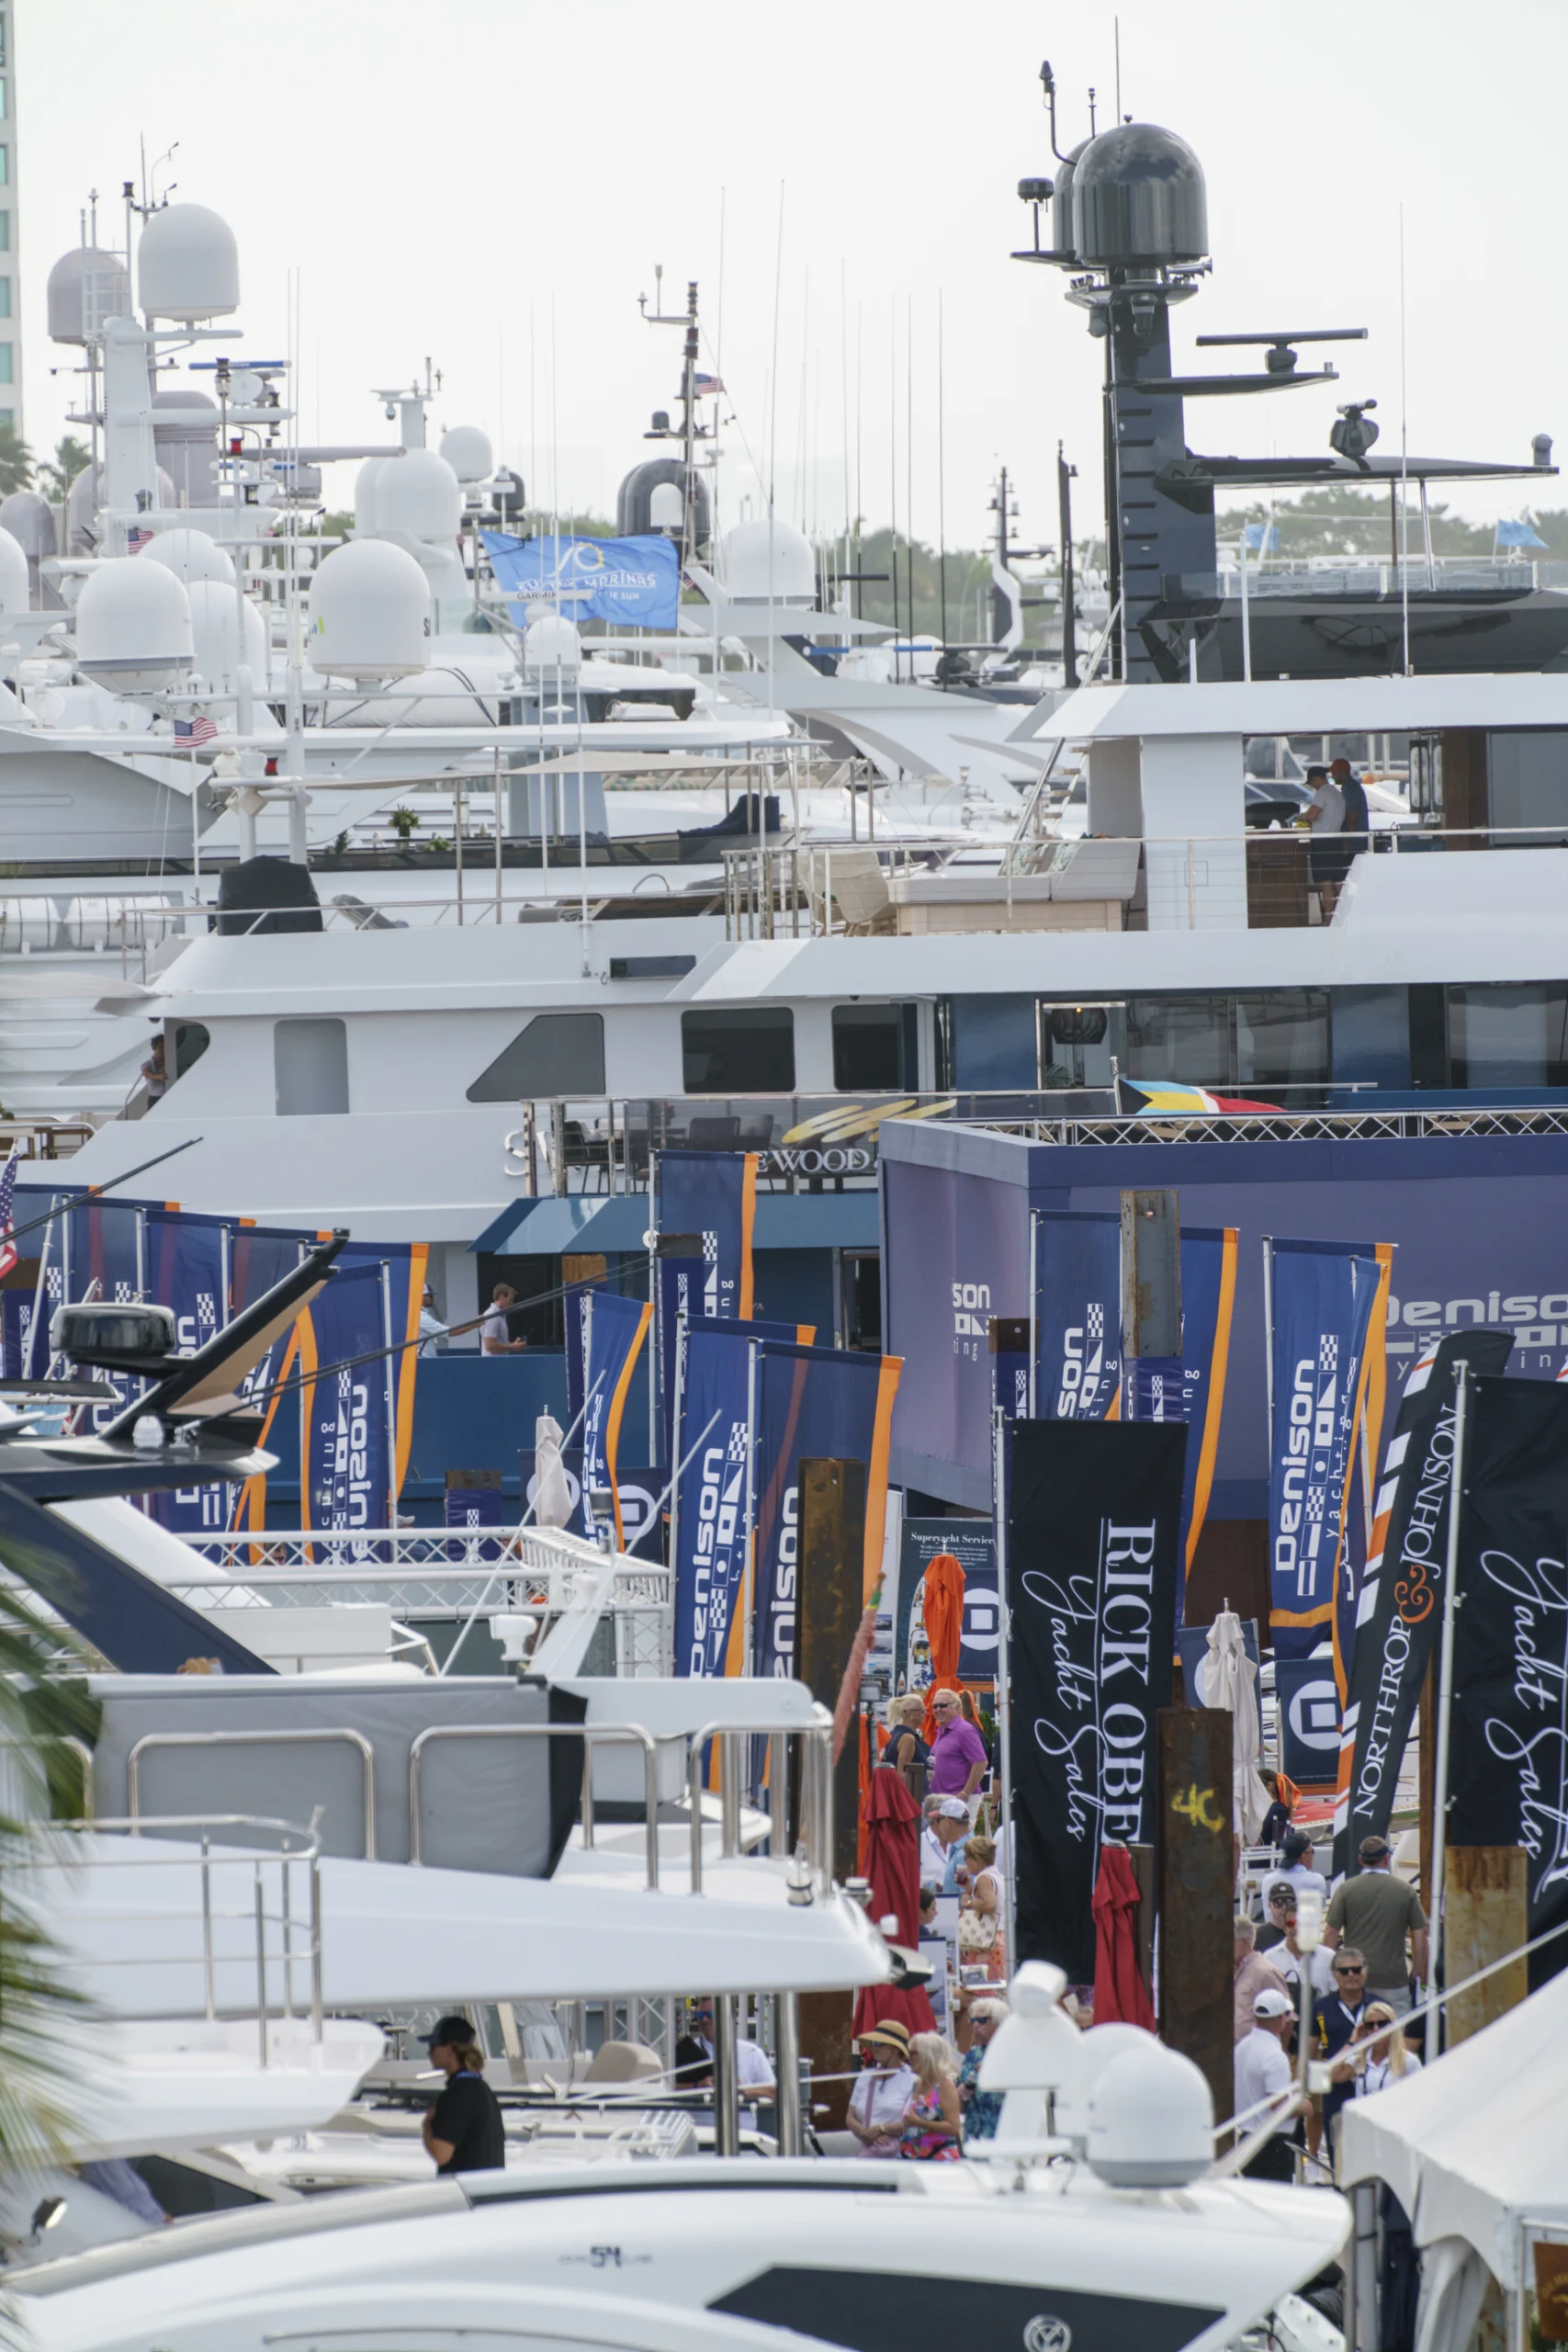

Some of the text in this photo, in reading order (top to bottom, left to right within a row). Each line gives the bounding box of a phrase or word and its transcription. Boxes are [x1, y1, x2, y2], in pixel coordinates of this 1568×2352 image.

[517, 591, 558, 600] GARMIN
[911, 1532, 995, 1544] Superyacht Service
[1276, 1360, 1314, 1571] Denison
[1021, 1570, 1108, 1842] Yacht Sales
[1100, 1518, 1156, 1845] RICK OBE
[1353, 1403, 1460, 1820] NORTHROP & JOHNSON
[1480, 1550, 1568, 1861] Yacht Sales
